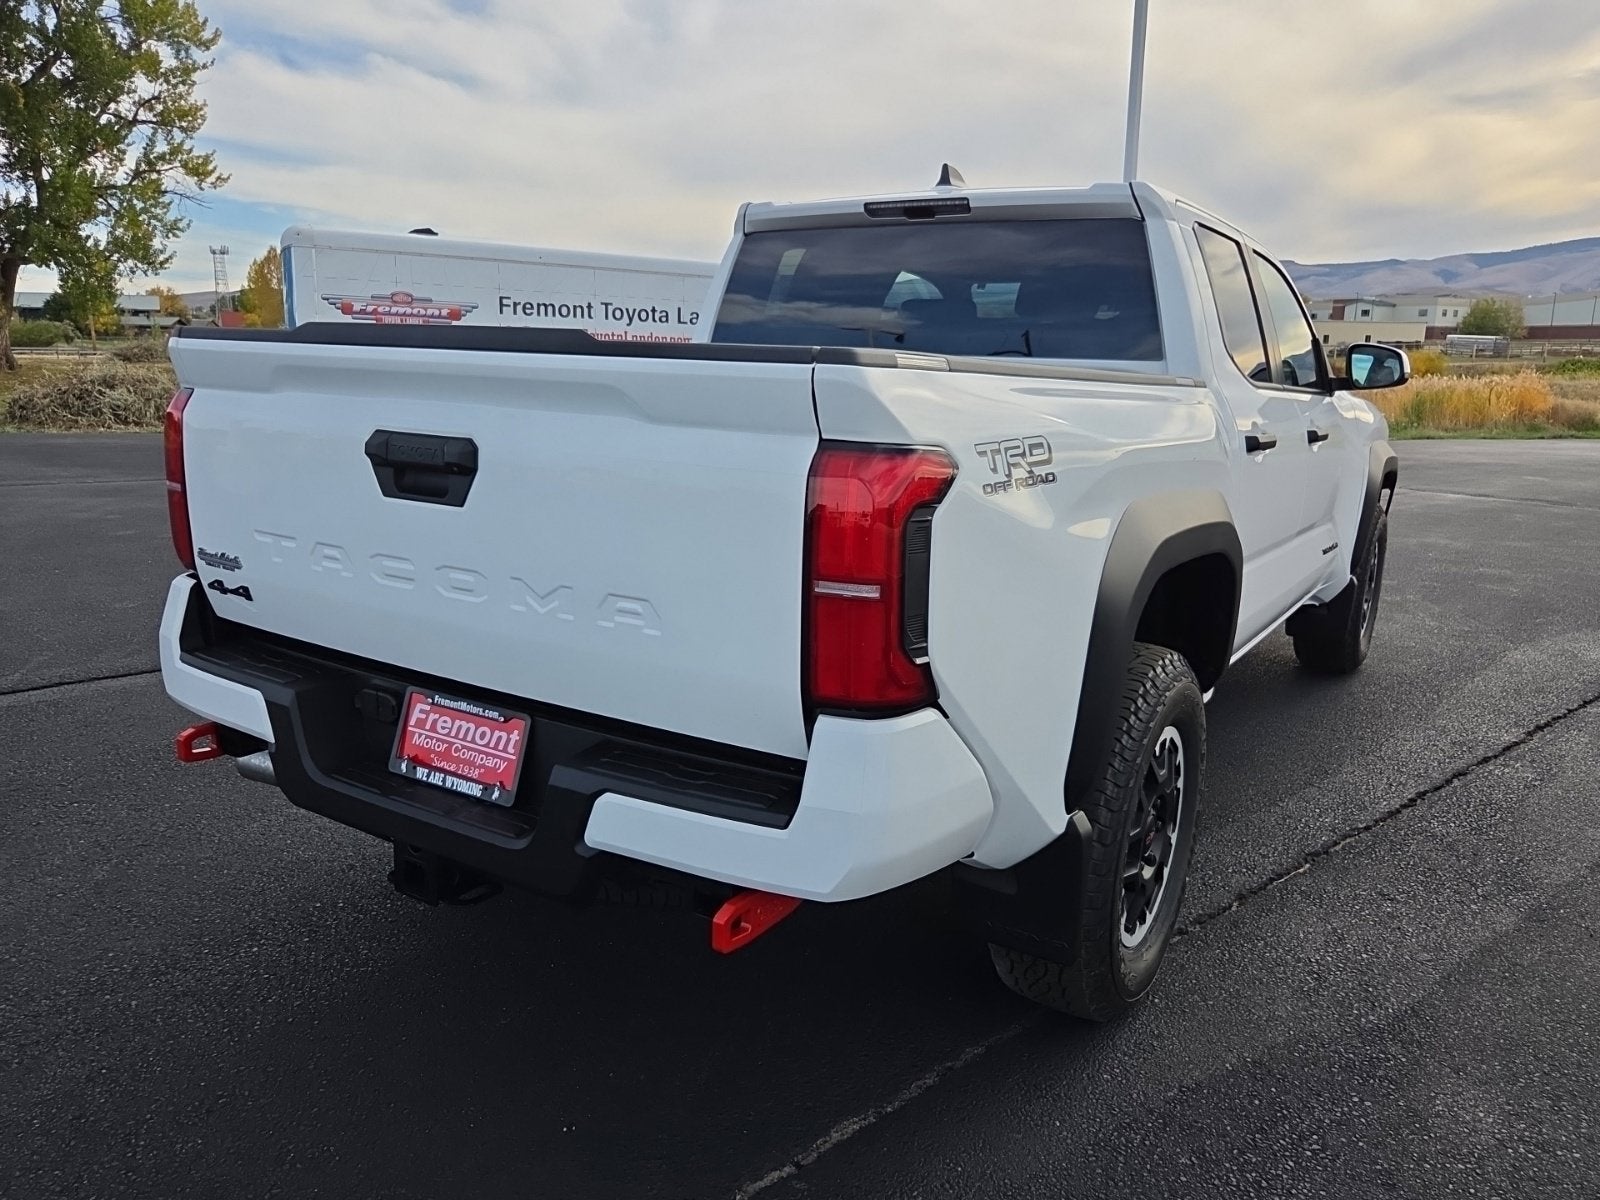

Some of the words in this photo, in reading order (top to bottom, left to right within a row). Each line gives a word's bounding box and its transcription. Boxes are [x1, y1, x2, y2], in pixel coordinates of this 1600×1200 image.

[350, 302, 452, 318] Fremont
[498, 296, 594, 320] Fremont
[600, 301, 670, 327] Toyota
[973, 434, 1054, 479] TRD
[982, 480, 1013, 498] OFF
[1014, 471, 1057, 491] ROAD
[253, 529, 662, 636] TACOMA
[434, 694, 499, 719] FremontMotors.com
[409, 702, 520, 754] Fremont
[412, 732, 449, 752] Motor
[451, 743, 508, 773] Company
[416, 767, 428, 780] WE
[428, 771, 443, 786] ARE
[445, 775, 483, 797] WYOMING
